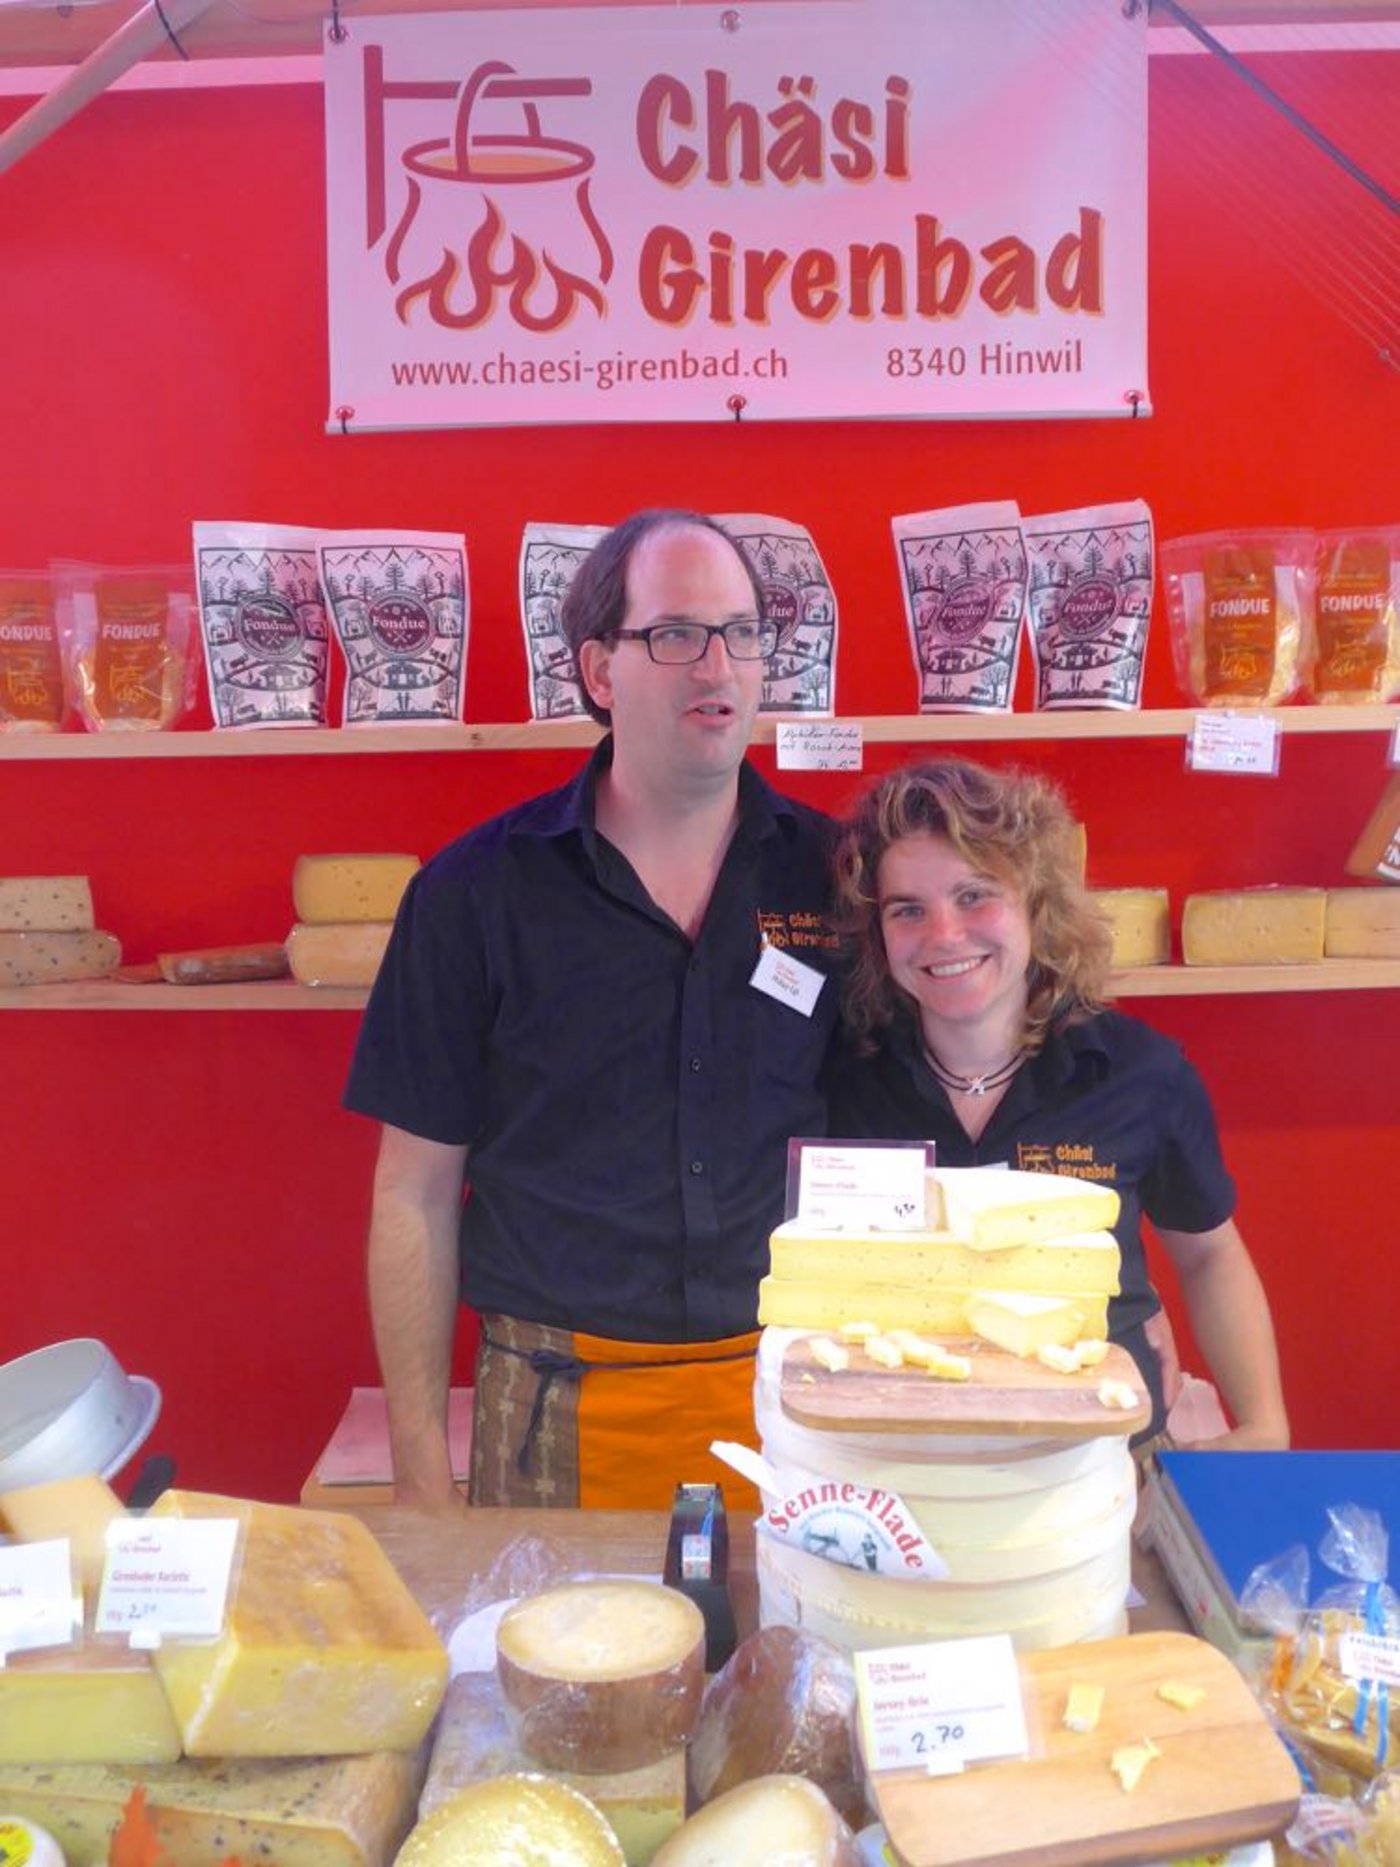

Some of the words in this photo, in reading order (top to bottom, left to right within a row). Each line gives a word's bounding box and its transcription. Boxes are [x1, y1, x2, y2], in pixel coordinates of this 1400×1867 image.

[636, 69, 912, 188] Chäsi
[638, 206, 1106, 328] Girenbad
[390, 347, 789, 390] www.chaesi-girenbad.ch
[886, 346, 967, 378] 8340
[979, 340, 1084, 377] Hinwil
[768, 603, 794, 617] due
[1210, 598, 1271, 618] FONDUE
[1320, 594, 1386, 613] FONDUE
[0, 624, 52, 641] ONDUE
[102, 623, 161, 640] FONDUE
[243, 619, 297, 632] Fondue
[371, 615, 427, 630] Fondue
[767, 1482, 925, 1569] Senne-Flade
[910, 1724, 965, 1754] 2.70
